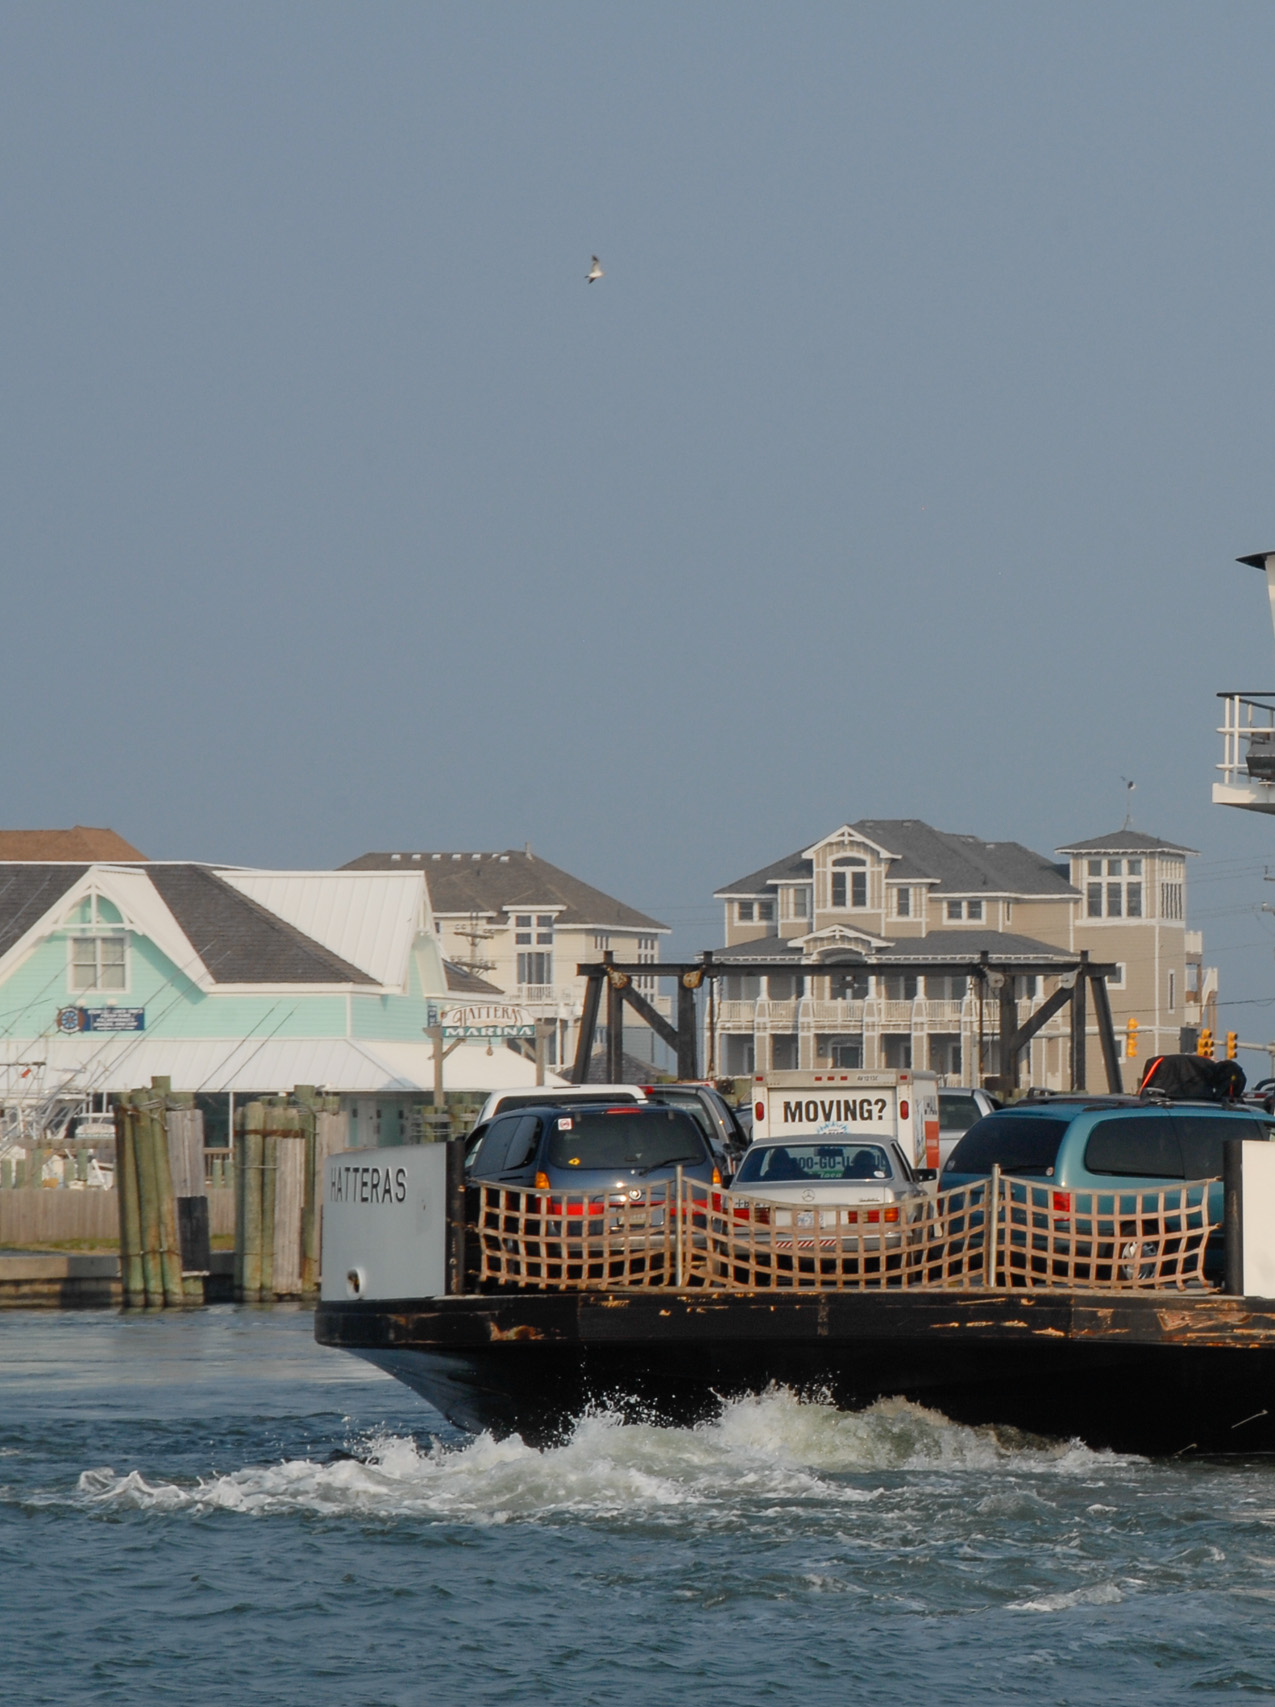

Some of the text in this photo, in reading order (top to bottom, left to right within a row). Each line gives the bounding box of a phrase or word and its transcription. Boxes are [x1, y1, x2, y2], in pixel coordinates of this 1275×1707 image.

[445, 1026, 532, 1037] MARINA
[783, 1098, 887, 1123] MOVING?
[330, 1166, 407, 1203] HATTERAS
